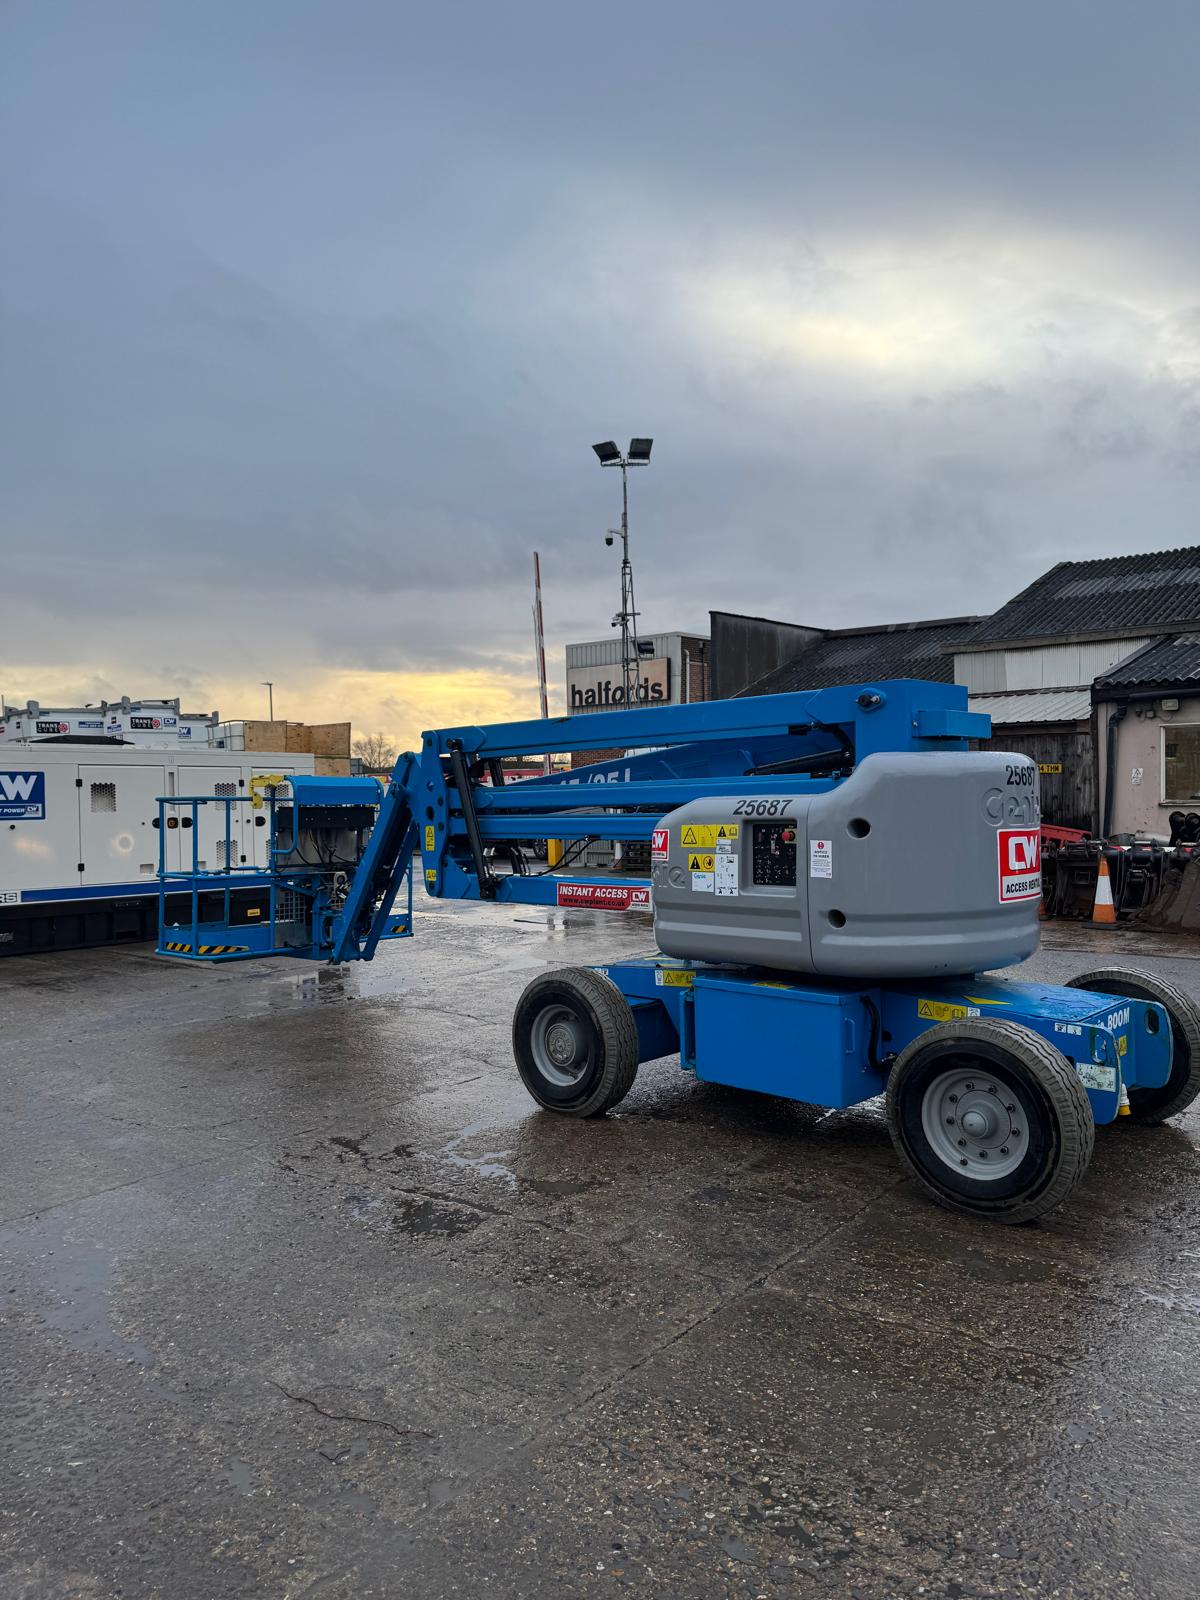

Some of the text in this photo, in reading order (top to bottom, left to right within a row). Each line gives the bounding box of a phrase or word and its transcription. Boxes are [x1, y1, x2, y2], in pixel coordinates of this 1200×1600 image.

[571, 677, 664, 706] halfords
[1005, 765, 1036, 788] 25687
[733, 799, 792, 816] 25687
[1008, 835, 1039, 871] CW
[559, 886, 628, 899] INSTANT ACCESS
[632, 892, 647, 901] CW
[1006, 881, 1028, 894] ACCESS
[1107, 1006, 1130, 1031] BOOM
